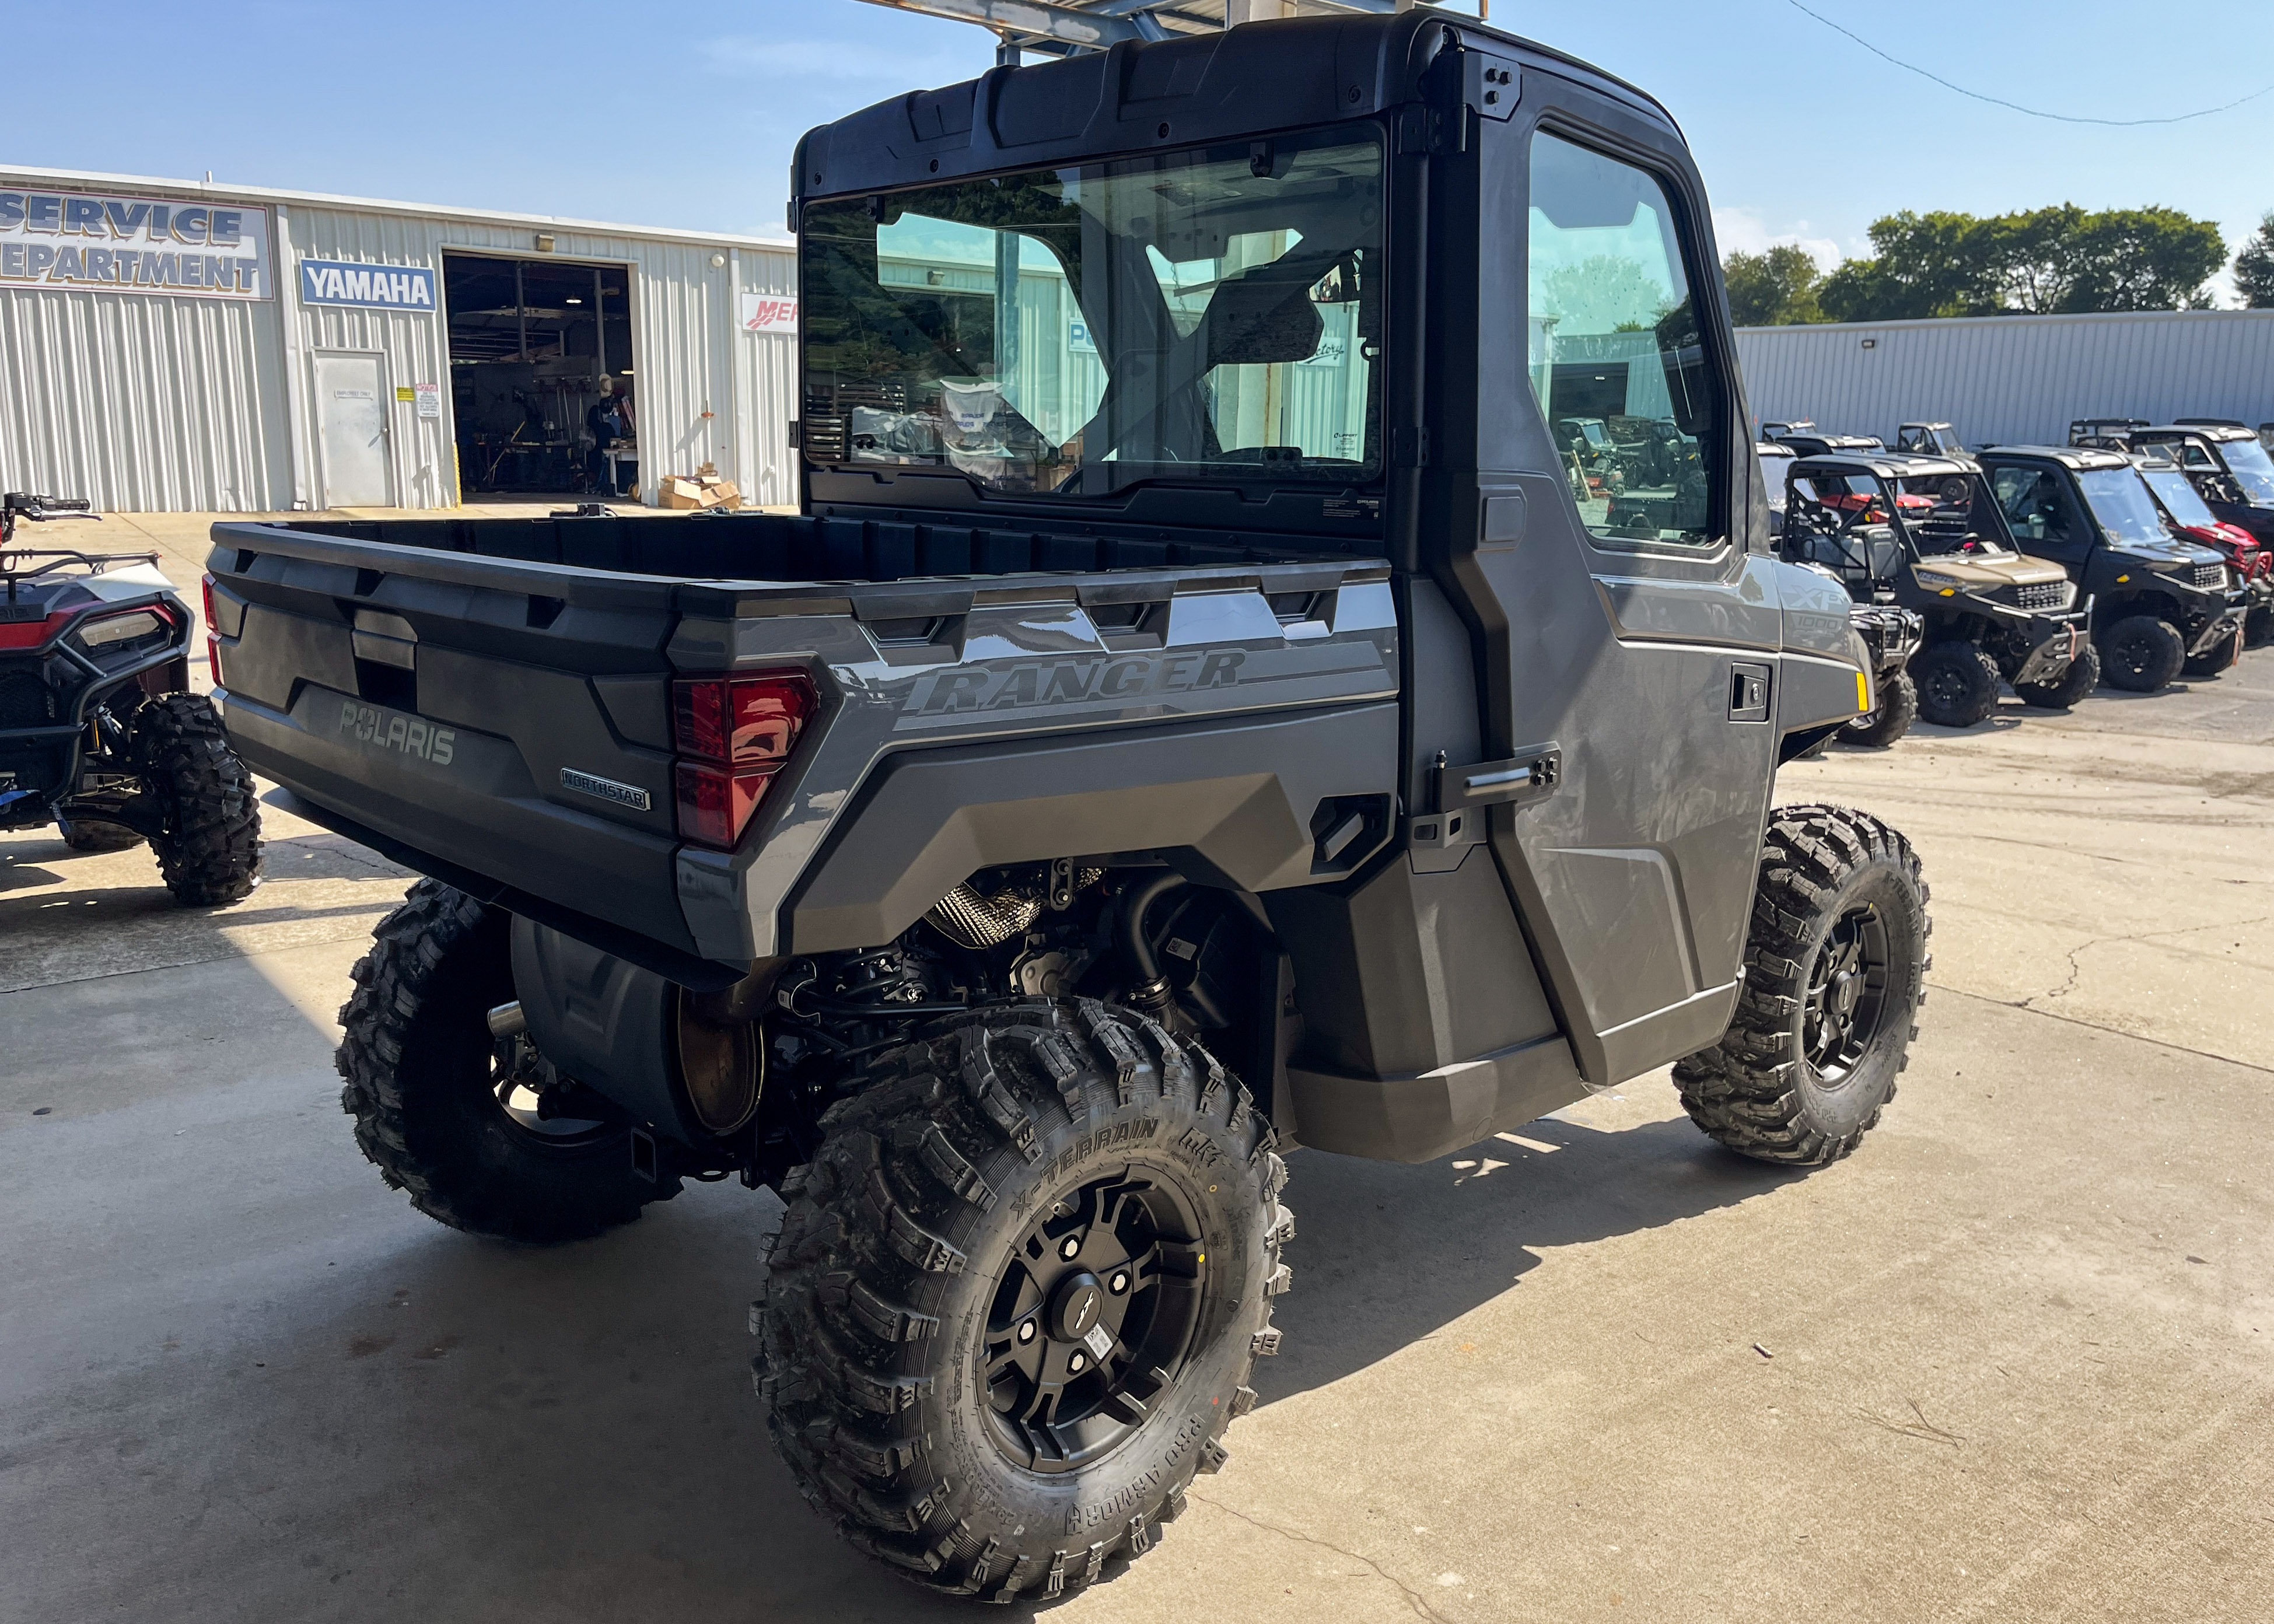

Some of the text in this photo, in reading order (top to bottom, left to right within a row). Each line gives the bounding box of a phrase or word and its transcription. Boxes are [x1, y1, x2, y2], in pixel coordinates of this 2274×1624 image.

[0, 193, 243, 246] SERVICE
[1, 242, 258, 290] EPARTMENT
[306, 267, 431, 305] YAMAHA
[1316, 343, 1344, 360] ctory
[1790, 584, 1845, 611] XP
[1798, 616, 1838, 629] 1000
[922, 651, 1247, 713] RANGER
[339, 701, 456, 766] POLARIS
[564, 771, 645, 807] NORTHSTAR
[1009, 1116, 1160, 1223] X-TERRAIN
[1086, 1460, 1164, 1528] ARMOR
